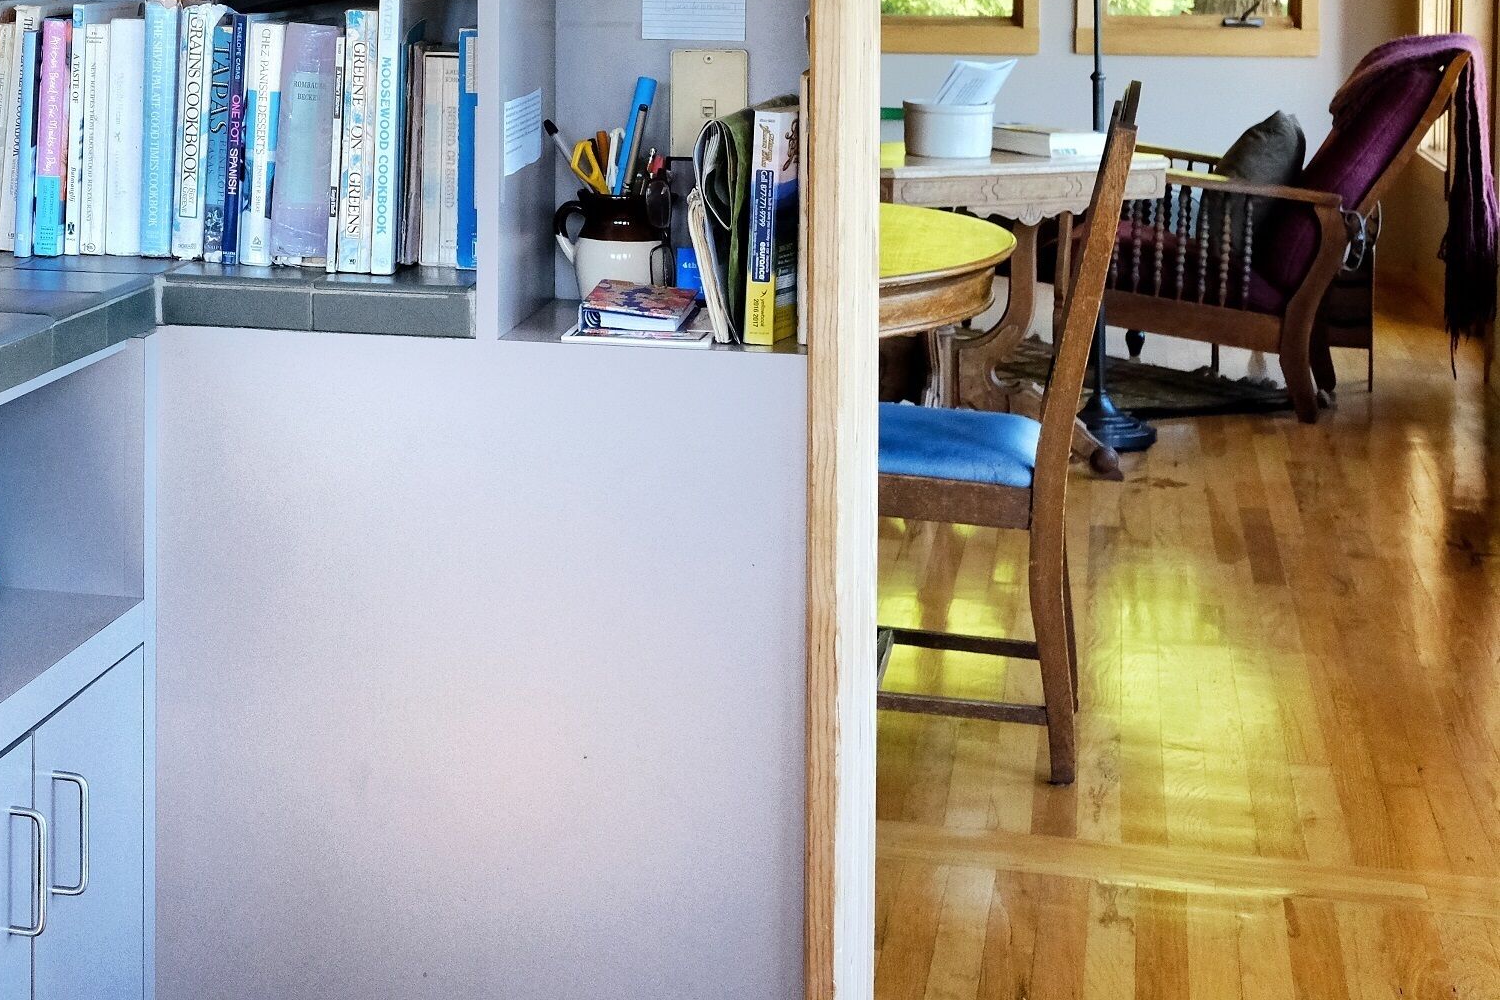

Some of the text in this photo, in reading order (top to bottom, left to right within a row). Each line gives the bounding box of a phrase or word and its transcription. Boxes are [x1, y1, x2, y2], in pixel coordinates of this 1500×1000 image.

[72, 61, 80, 90] TASTE
[152, 40, 163, 73] SILVER
[72, 91, 79, 104] OF
[184, 17, 203, 181] GRAINS COOKBOOK
[210, 41, 230, 134] TAPAS
[255, 28, 271, 155] CHEZ PANISSE DESSERTS
[150, 112, 161, 139] GOOD
[227, 94, 241, 196] ONE POT SPANISH
[347, 42, 366, 234] GREENE ON GREENS
[44, 157, 56, 173] Day
[149, 141, 160, 171] TIMES
[376, 57, 392, 235] MOOSEWOOD COOKBOOK
[760, 170, 768, 183] Call
[147, 172, 159, 228] COOKBOOK
[758, 241, 766, 280] esurance
